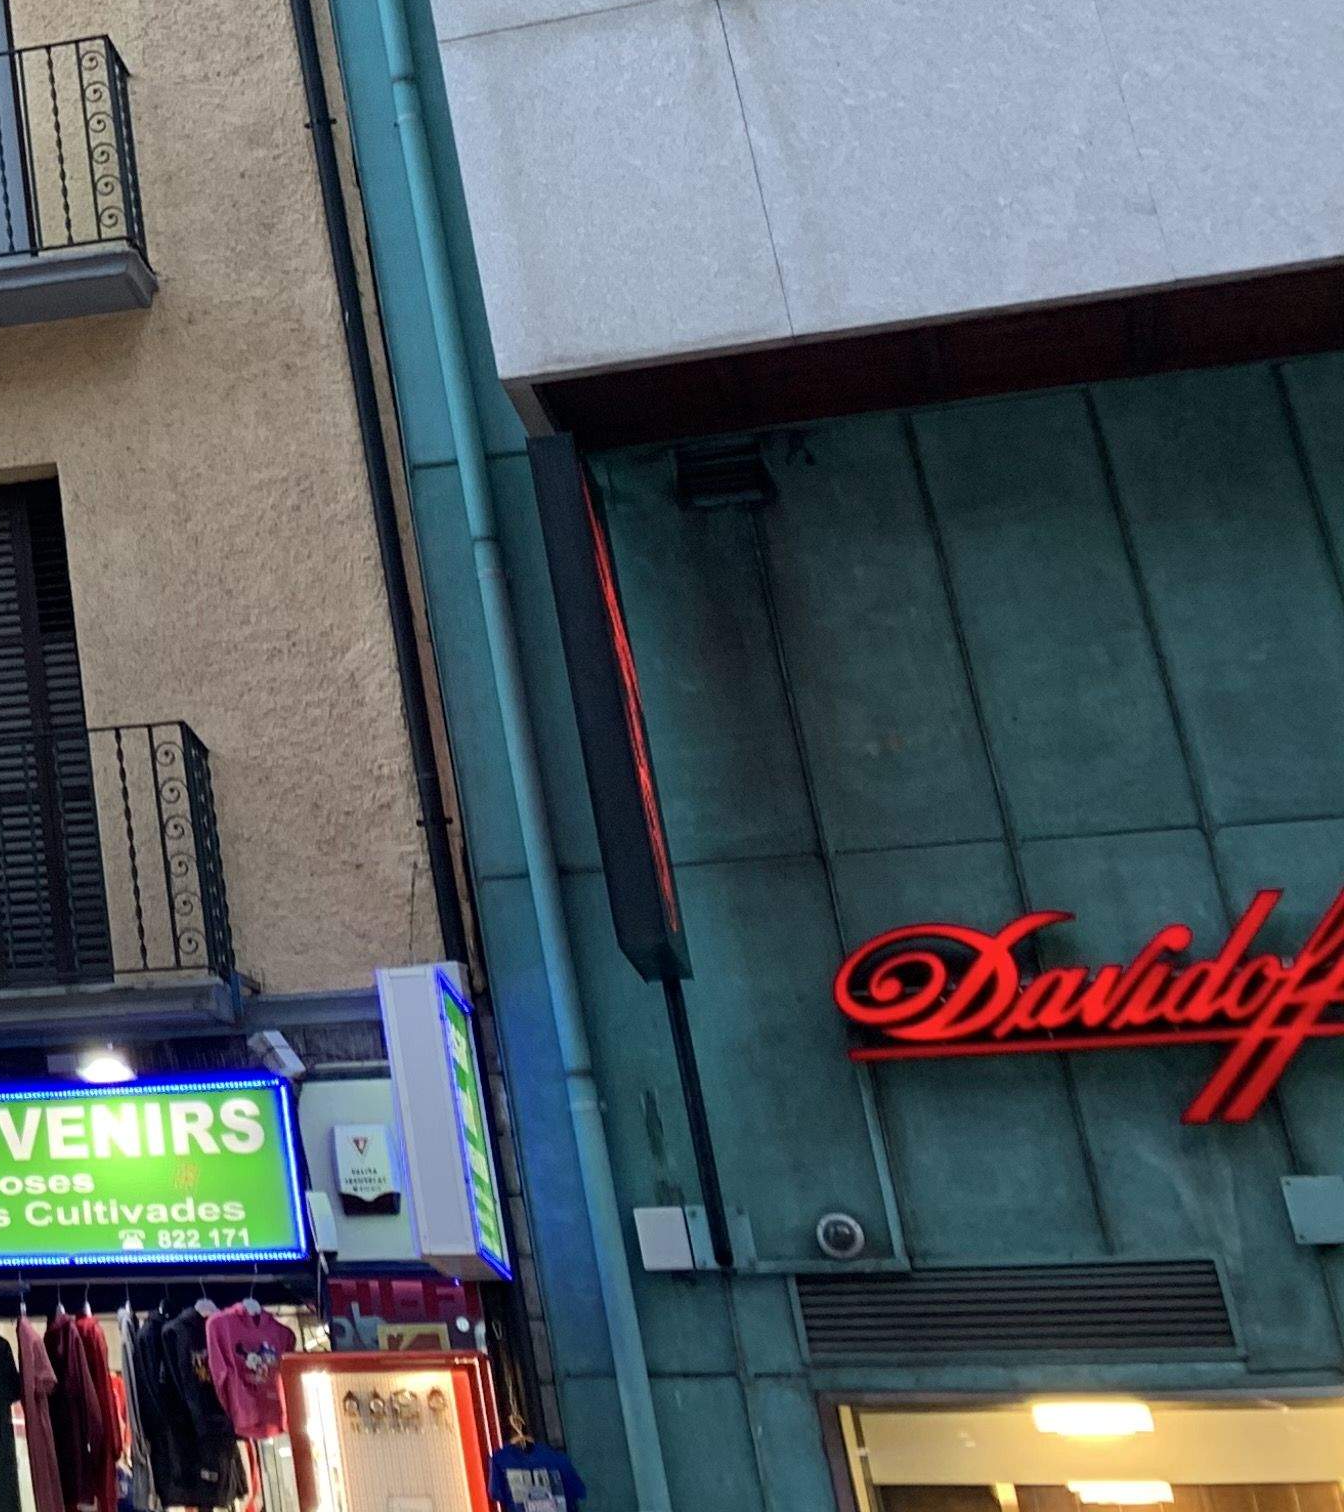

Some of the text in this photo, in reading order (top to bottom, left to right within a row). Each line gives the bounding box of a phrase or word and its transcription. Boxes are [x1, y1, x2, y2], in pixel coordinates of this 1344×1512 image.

[23, 1195, 247, 1228] Cultivades
[156, 1227, 251, 1250] 822 171
